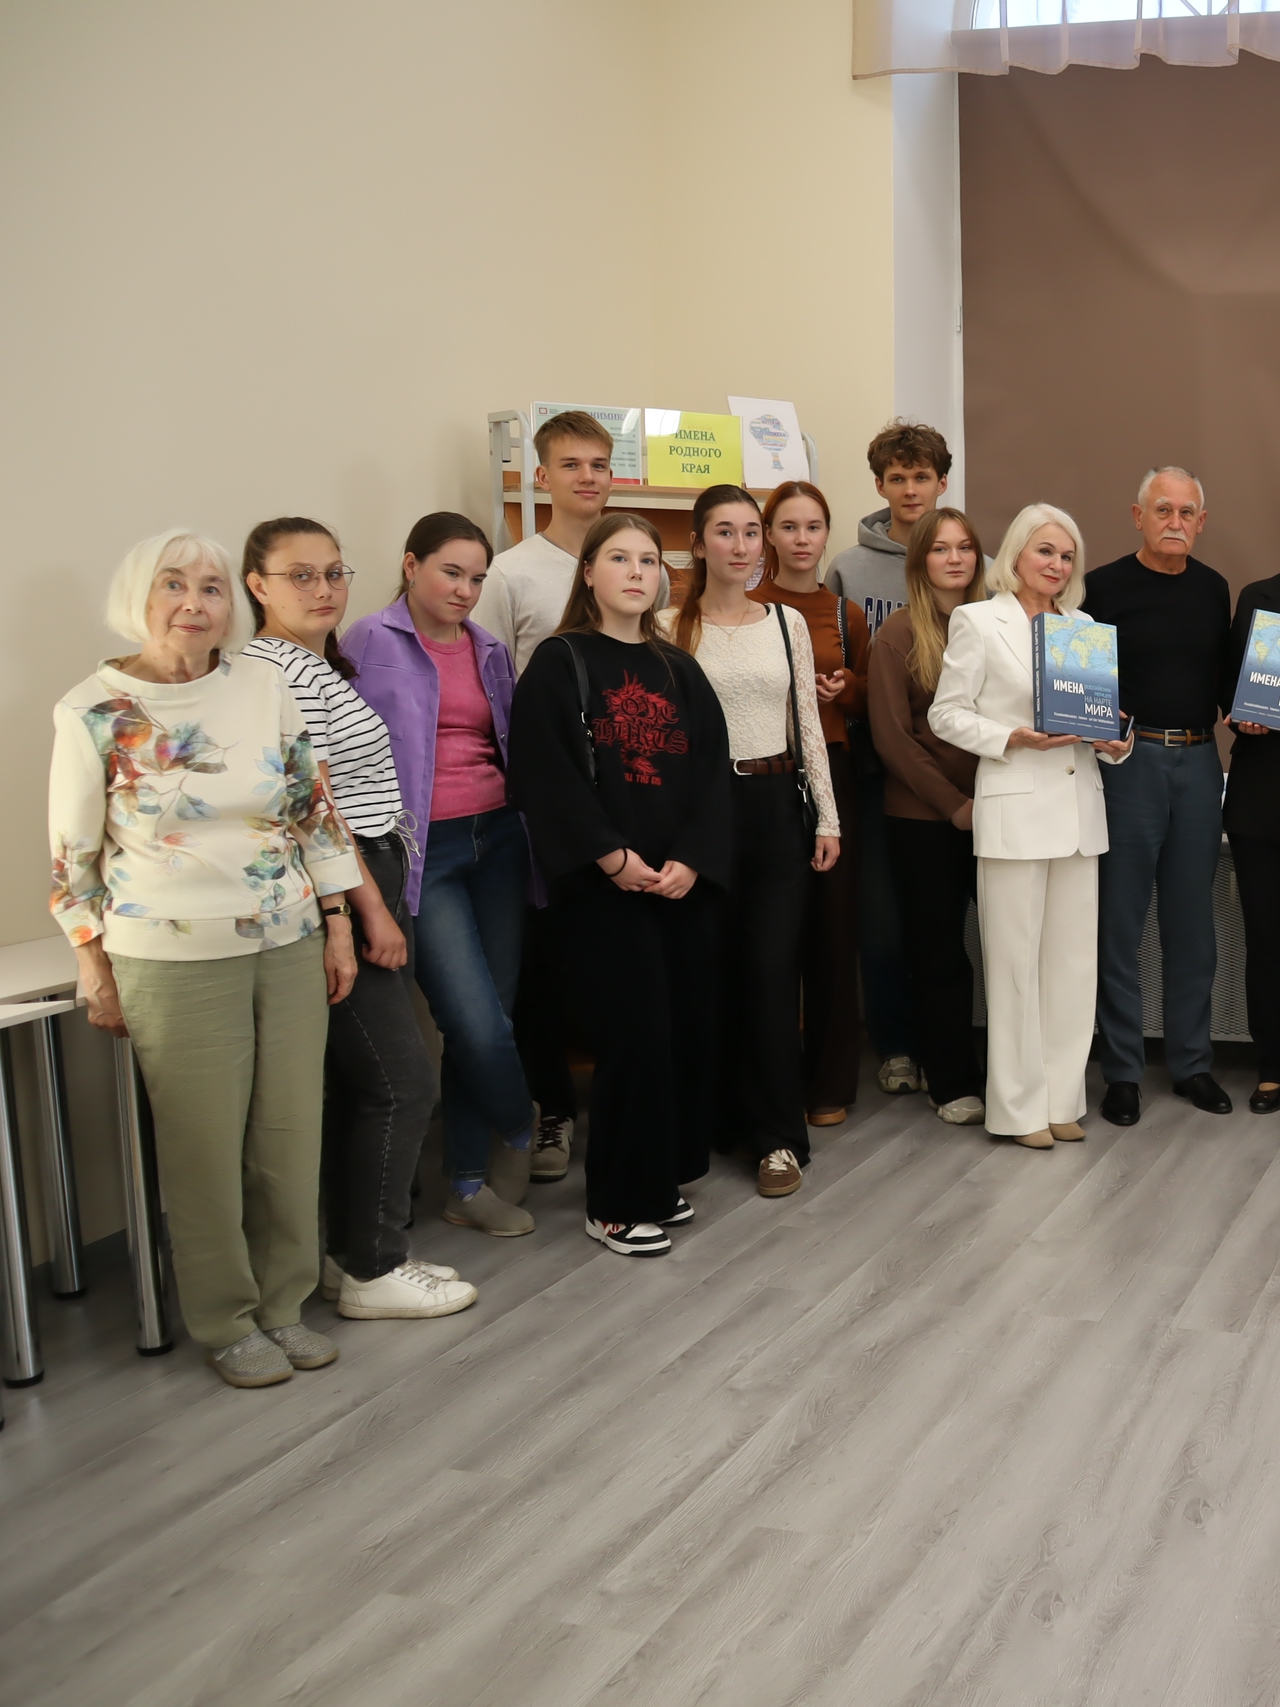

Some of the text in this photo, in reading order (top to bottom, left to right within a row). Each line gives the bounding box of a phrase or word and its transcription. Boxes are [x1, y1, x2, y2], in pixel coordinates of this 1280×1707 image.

[675, 430, 716, 441] ИМЕНА
[669, 445, 722, 458] РОДНОГО
[681, 463, 710, 474] КРАЯ
[1054, 679, 1084, 694] ИМЕНА
[1085, 703, 1113, 718] МИРА
